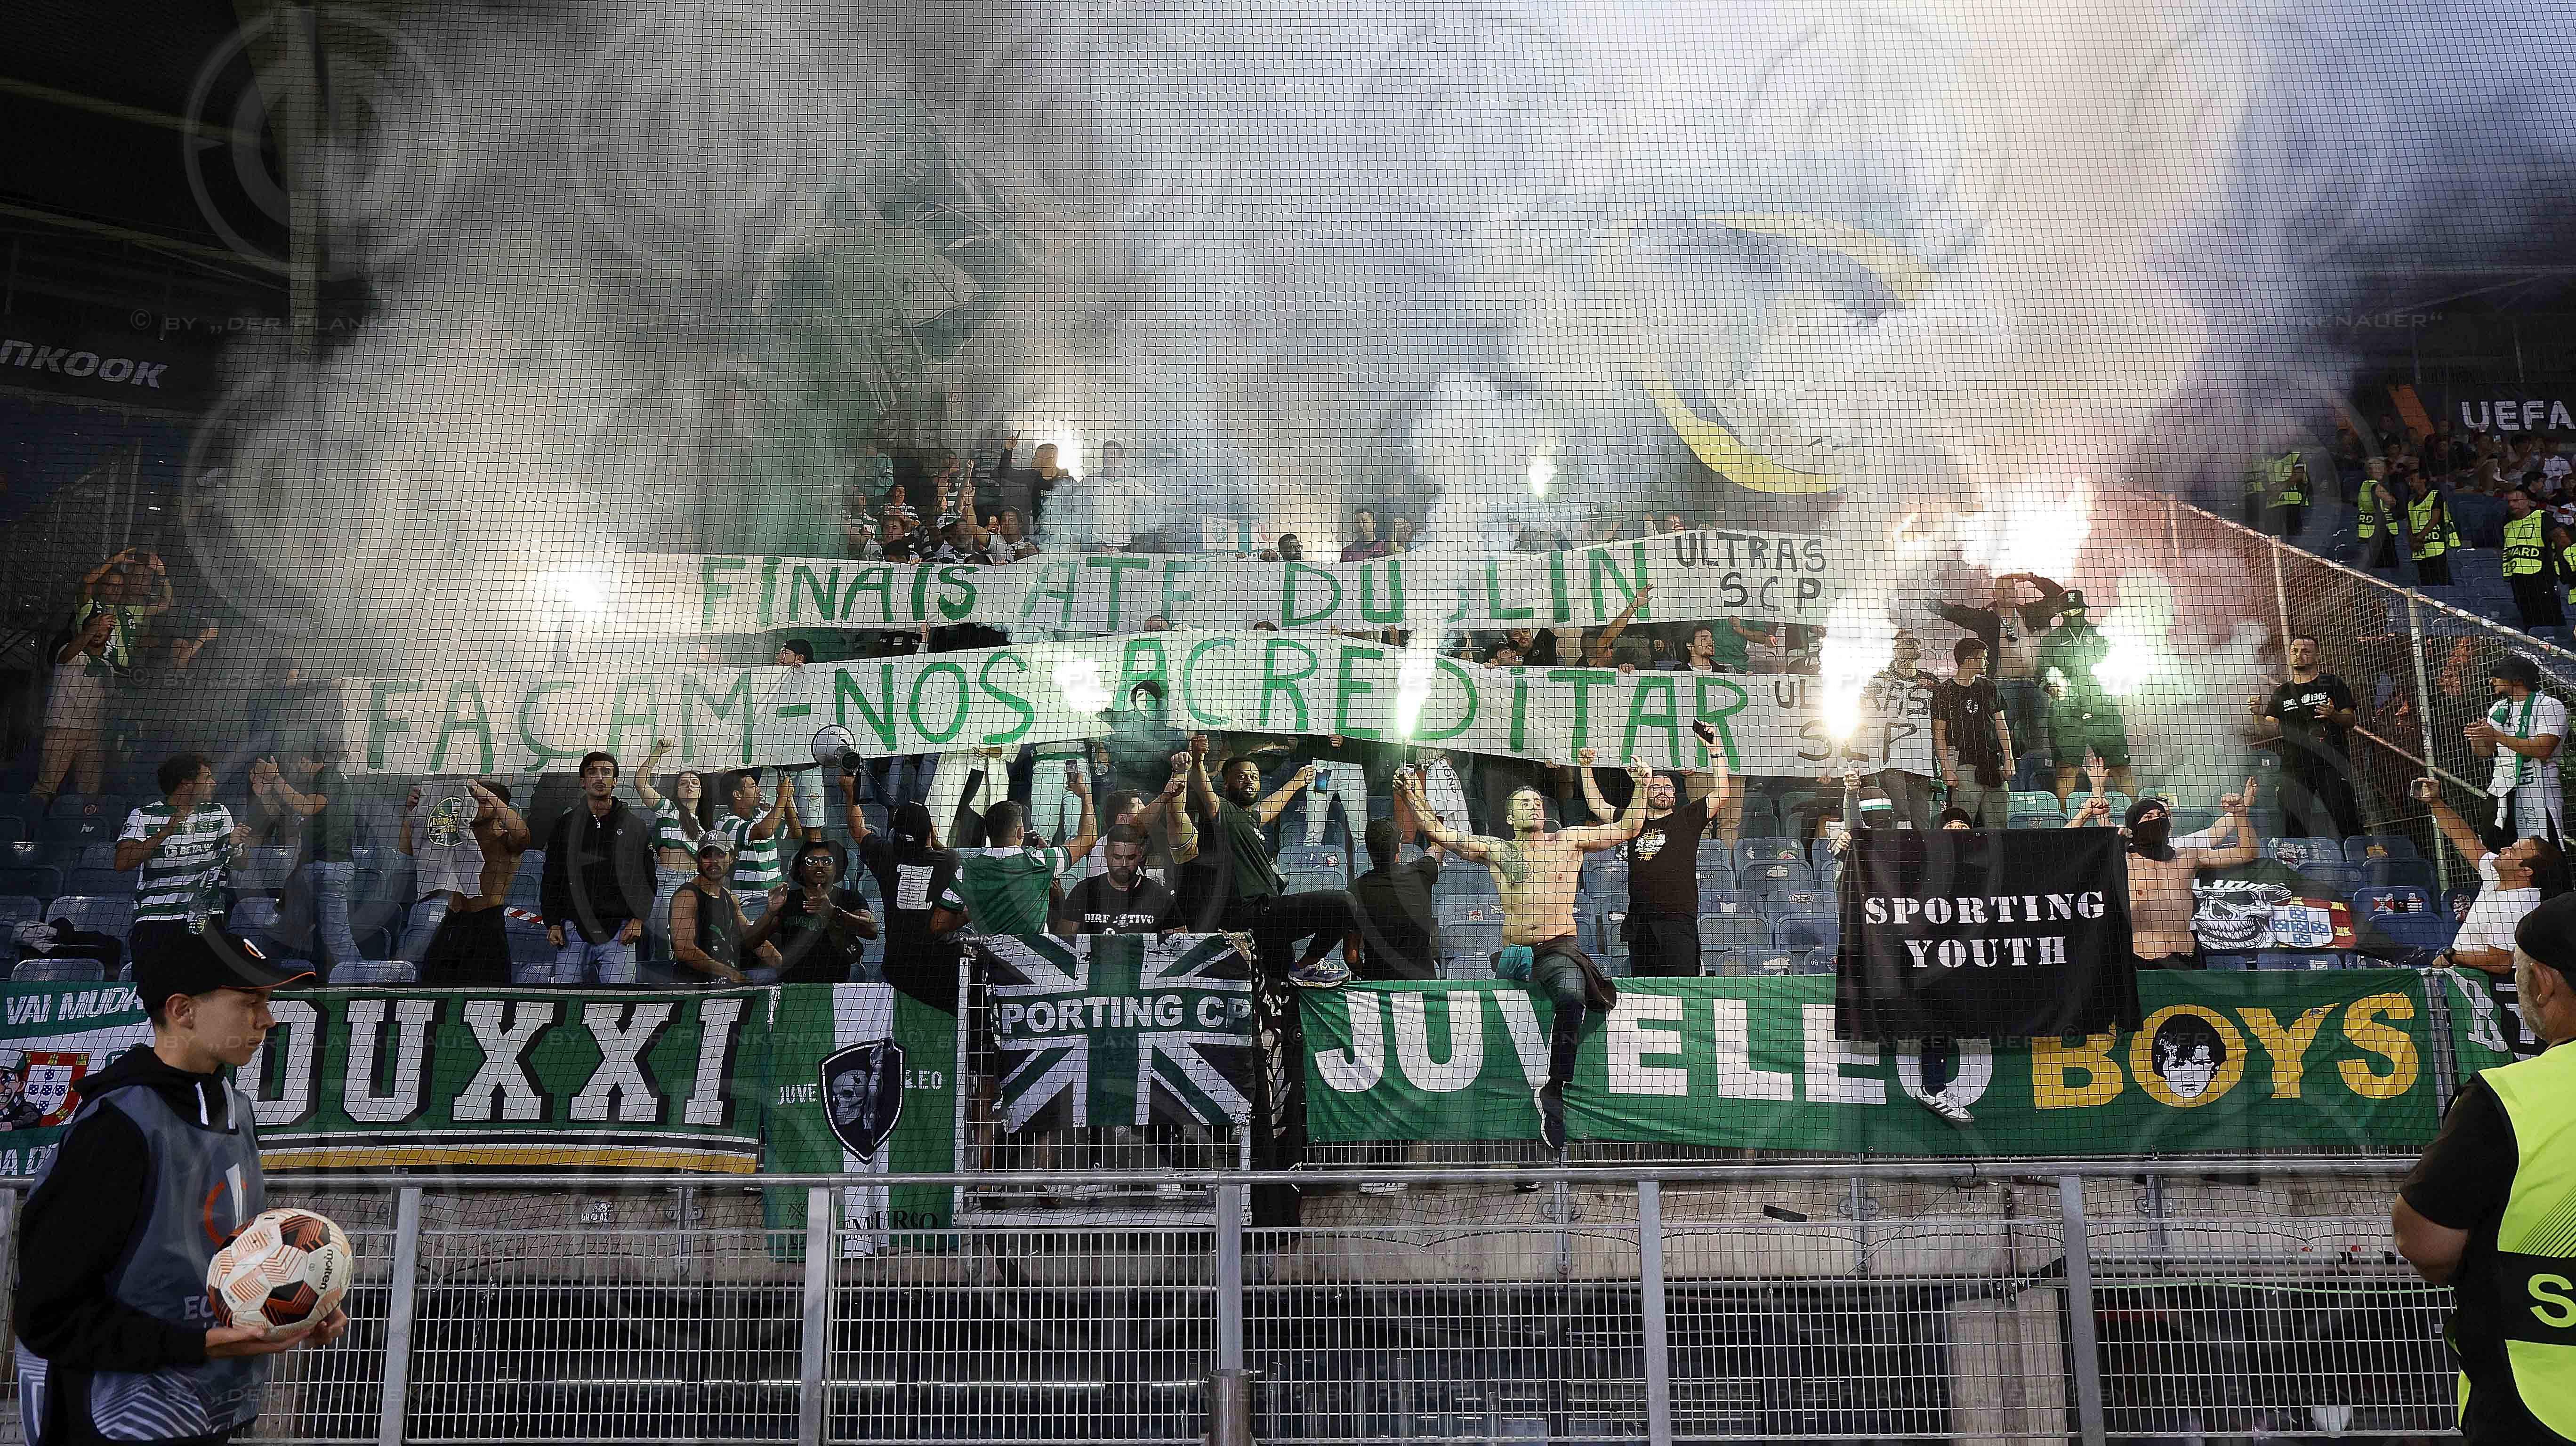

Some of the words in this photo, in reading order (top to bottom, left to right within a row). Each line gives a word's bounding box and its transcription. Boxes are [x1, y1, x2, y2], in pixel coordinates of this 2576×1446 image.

[2461, 400, 2576, 432] UEFA
[1674, 531, 1827, 573] ULTRAS
[1720, 572, 1822, 614] SCP
[1864, 891, 2105, 925] SPORTING
[1904, 936, 2067, 968] YOUTH
[6, 994, 51, 1026] VAI
[1196, 995, 1251, 1029] CP
[2031, 991, 2419, 1109] BOYS
[777, 1083, 818, 1105] JUVE
[319, 1249, 334, 1290] molten
